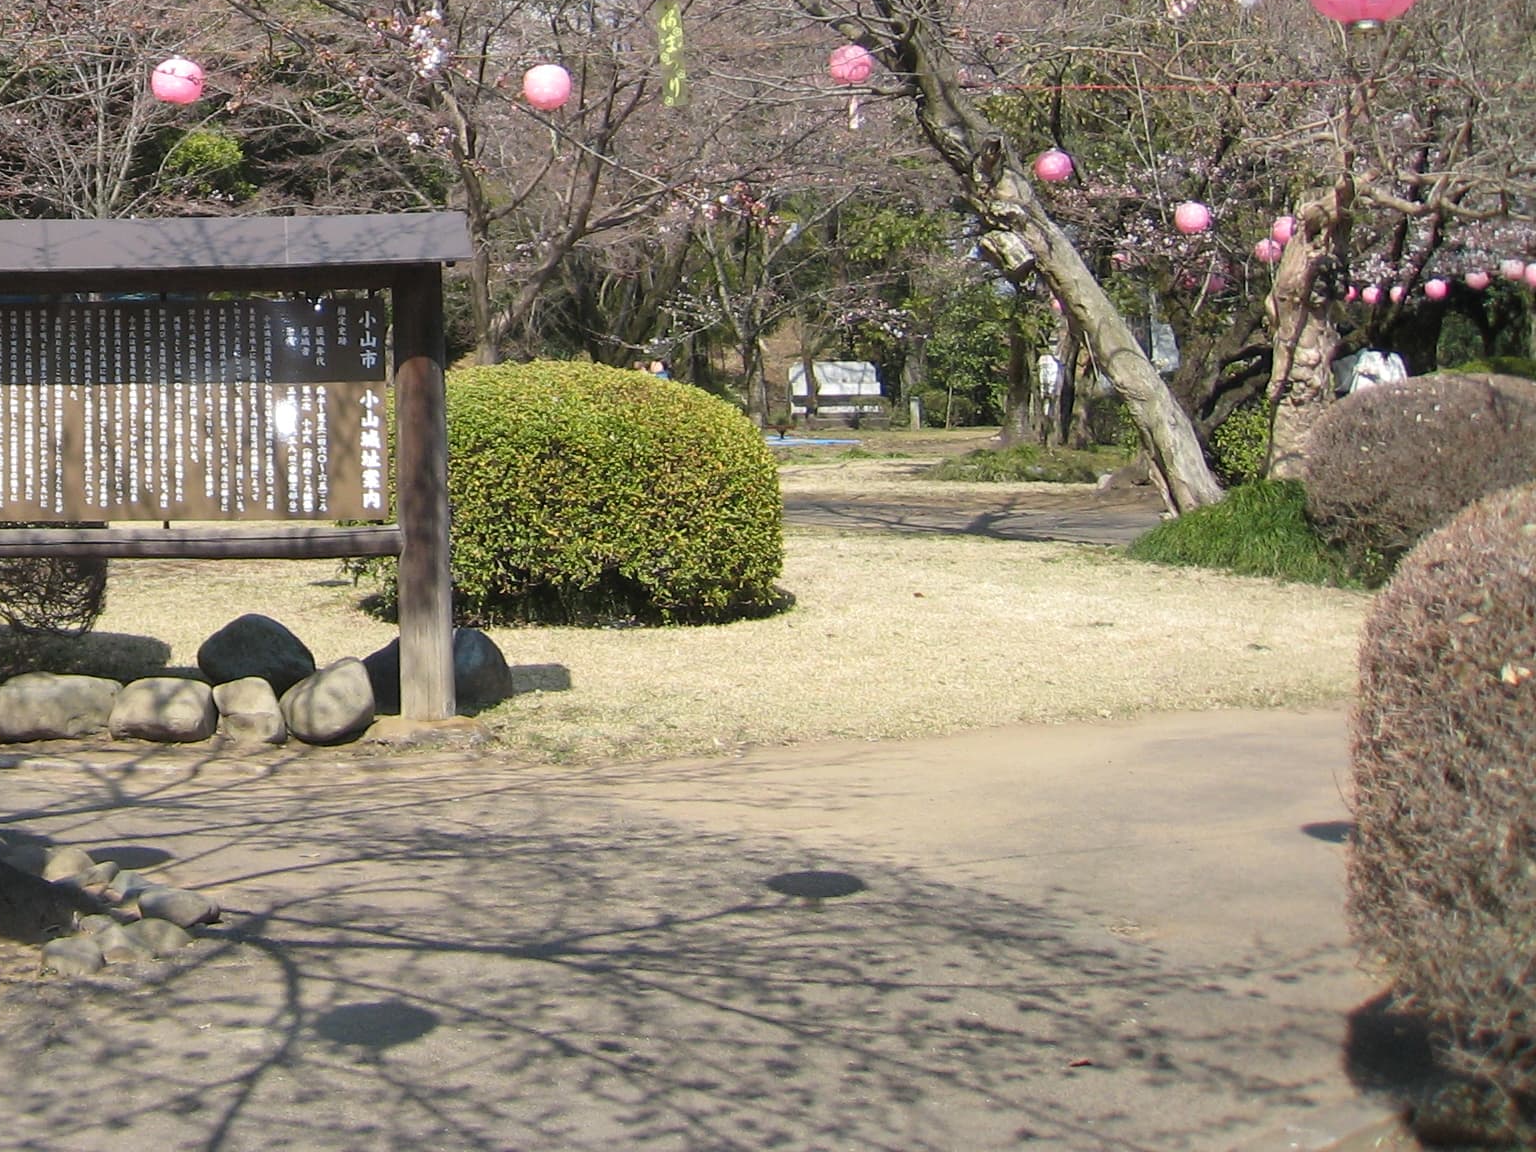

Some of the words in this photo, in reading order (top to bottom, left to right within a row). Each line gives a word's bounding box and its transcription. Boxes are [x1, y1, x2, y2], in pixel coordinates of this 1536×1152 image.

[358, 310, 378, 369] 小山市
[359, 389, 381, 509] 小山城址案内
